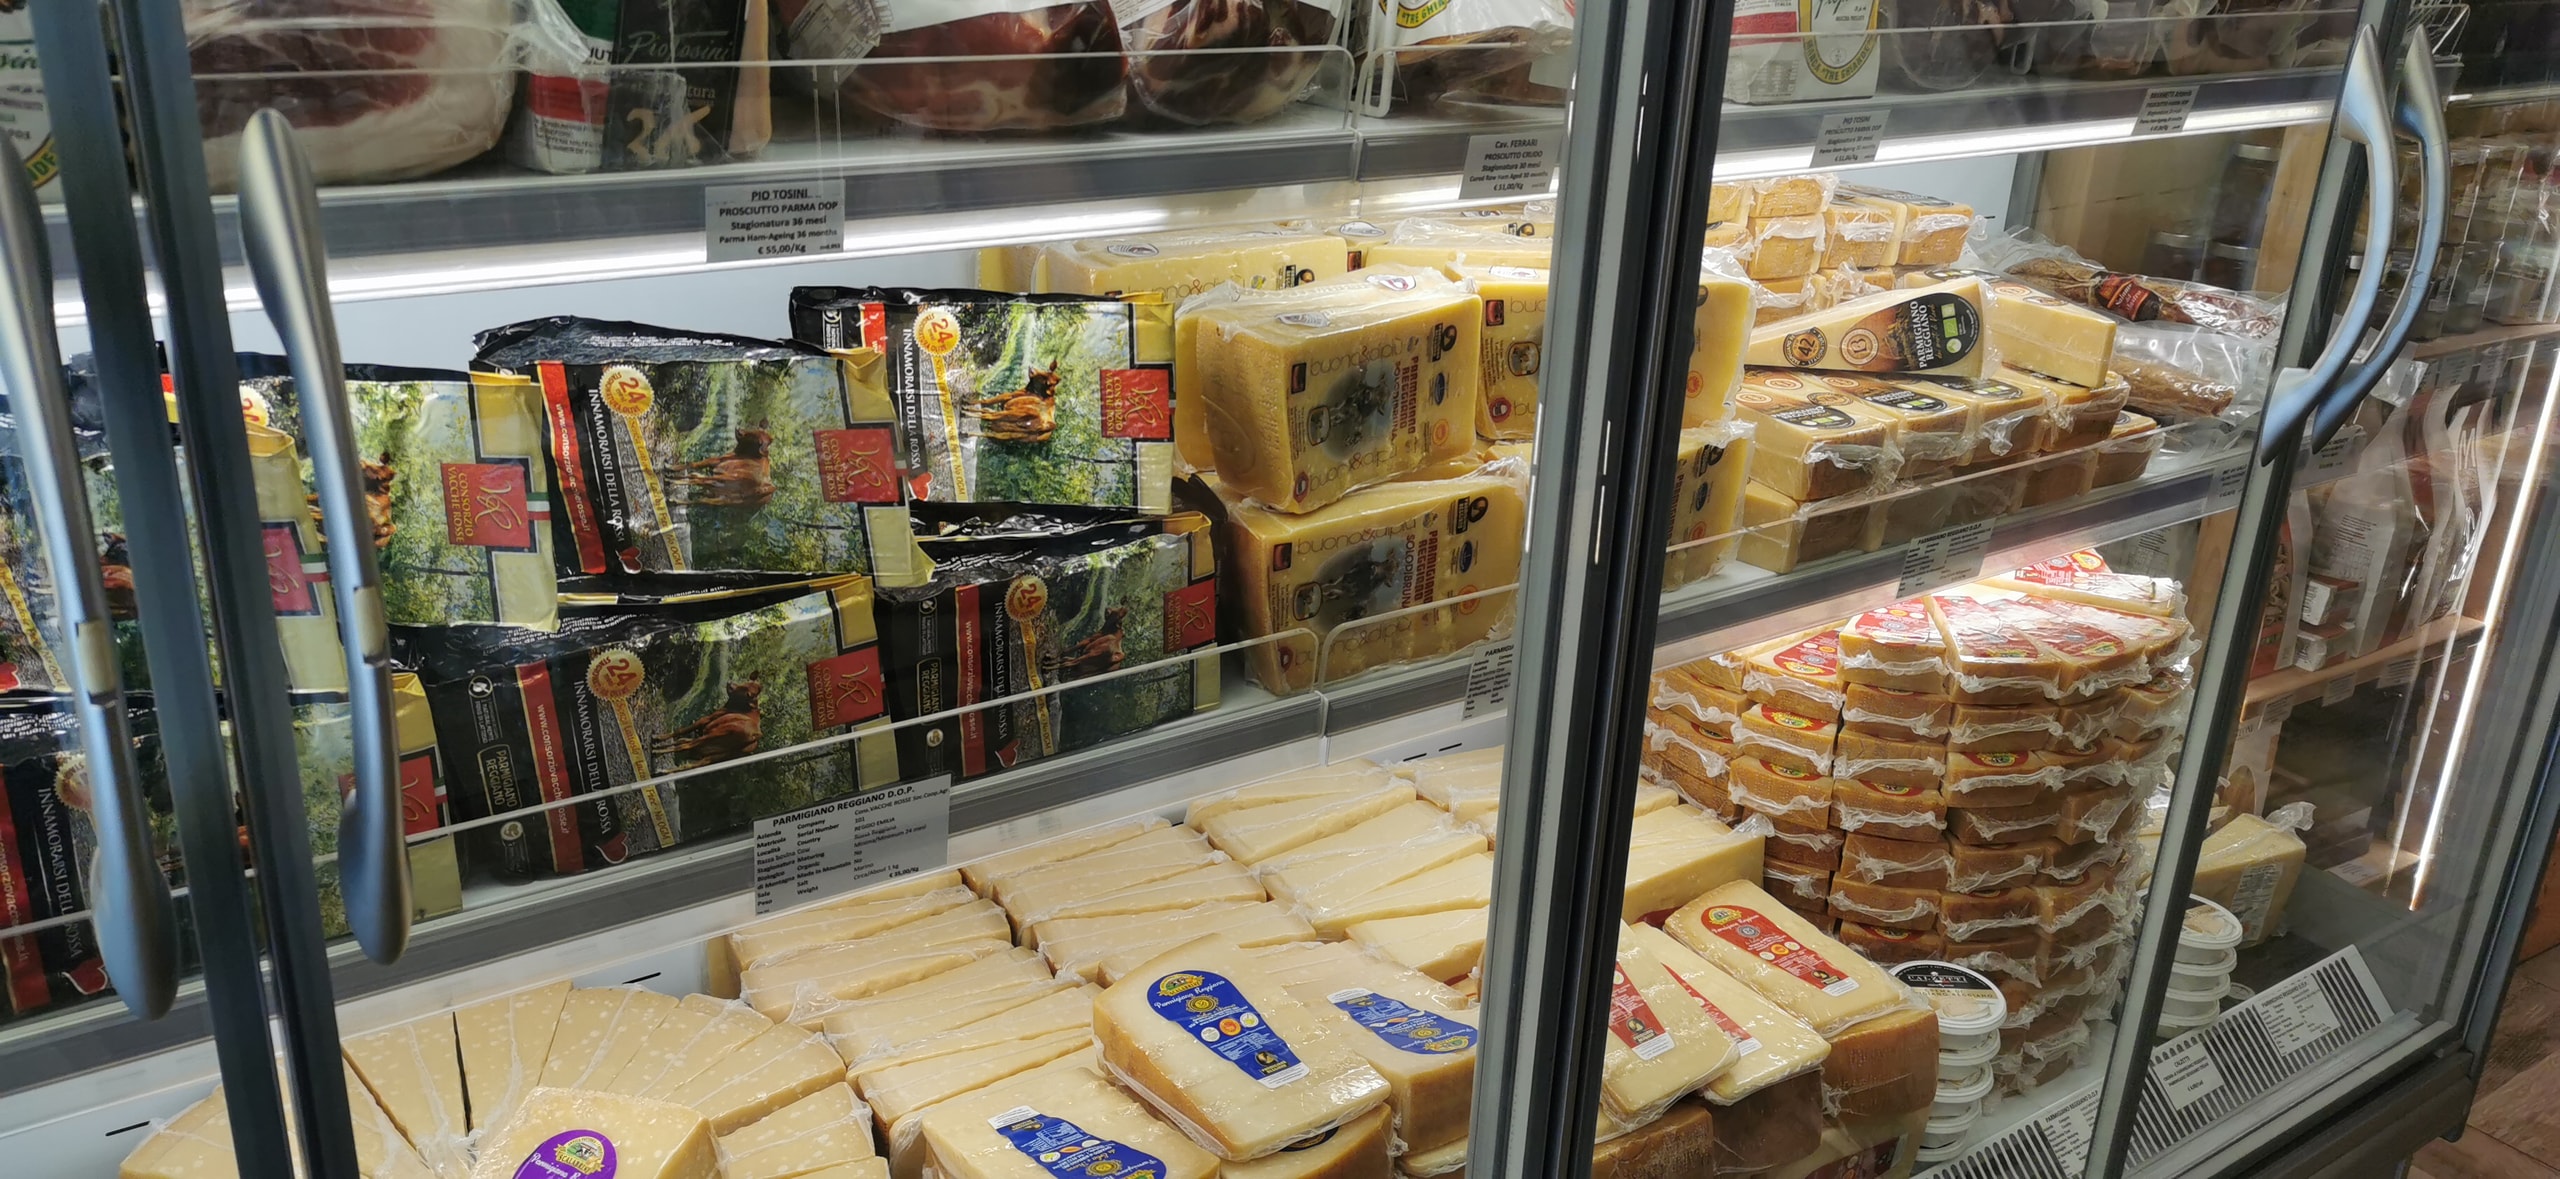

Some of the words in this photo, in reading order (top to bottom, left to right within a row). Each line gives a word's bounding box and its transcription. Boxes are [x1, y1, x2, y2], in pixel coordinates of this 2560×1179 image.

[1484, 152, 1521, 160] PROSCIUTTO
[1510, 139, 1538, 148] FERRARI
[751, 190, 770, 202] PIO
[773, 188, 808, 199] TOSINI
[719, 205, 779, 216] PROSCIUTTO
[781, 203, 815, 213] PARMA
[818, 201, 838, 211] DOP
[731, 218, 790, 230] Stagionatura
[792, 217, 803, 225] 36
[805, 215, 827, 224] mesi
[719, 235, 745, 243] Parma
[747, 231, 795, 242] Ham-Ageing
[797, 230, 807, 238] 36
[808, 229, 837, 238] months
[758, 247, 764, 255] €
[766, 243, 806, 254] 55,00/Kg
[931, 318, 954, 343] 24
[1910, 301, 1927, 368] PARMIGIANO
[1919, 305, 1934, 360] REGGIANO
[1798, 338, 1815, 357] 42
[903, 329, 916, 403] INNAMORARSI
[619, 377, 647, 403] 24
[1400, 367, 1410, 430] REGGIANO
[1407, 356, 1419, 435] PARMIGIANO
[907, 406, 917, 437] DELLA
[588, 389, 613, 470] INNAMORARSI
[605, 473, 619, 507] DELLA
[910, 438, 921, 470] ROSSA
[448, 467, 461, 509] VACCHE
[458, 473, 474, 537] CONSORZIO
[453, 511, 464, 542] ROSSE
[670, 546, 682, 567] OGM
[1021, 583, 1042, 608] 24
[607, 658, 637, 686] 24
[574, 681, 598, 762] INNAMORARSI
[596, 800, 612, 834] ROSSA
[486, 759, 505, 806] REGGIANO
[496, 750, 518, 807] PARMIGIANO
[772, 805, 835, 828] PARMIGIANO
[837, 793, 886, 811] REGGIANO
[887, 786, 915, 799] D.O.P.
[38, 788, 68, 881] INNAMORARSI
[657, 822, 671, 841] OGM
[756, 830, 782, 841] Azienda
[797, 819, 826, 831] Company
[756, 837, 786, 849] Matricola
[797, 829, 814, 839] Serial
[815, 823, 840, 834] Number
[756, 847, 781, 857] Località
[797, 836, 821, 847] Country
[854, 821, 876, 831] REGGIO
[877, 817, 896, 826] EMILIA
[756, 859, 795, 874] Stagionatura
[797, 852, 825, 863] Maturing
[757, 871, 785, 882] Biologico
[797, 861, 820, 871] Organic
[765, 876, 795, 888] Montagna
[797, 870, 814, 879] Made
[797, 885, 819, 895] Weight
[757, 890, 771, 898] Sale
[1154, 993, 1194, 1009] Parmigiano
